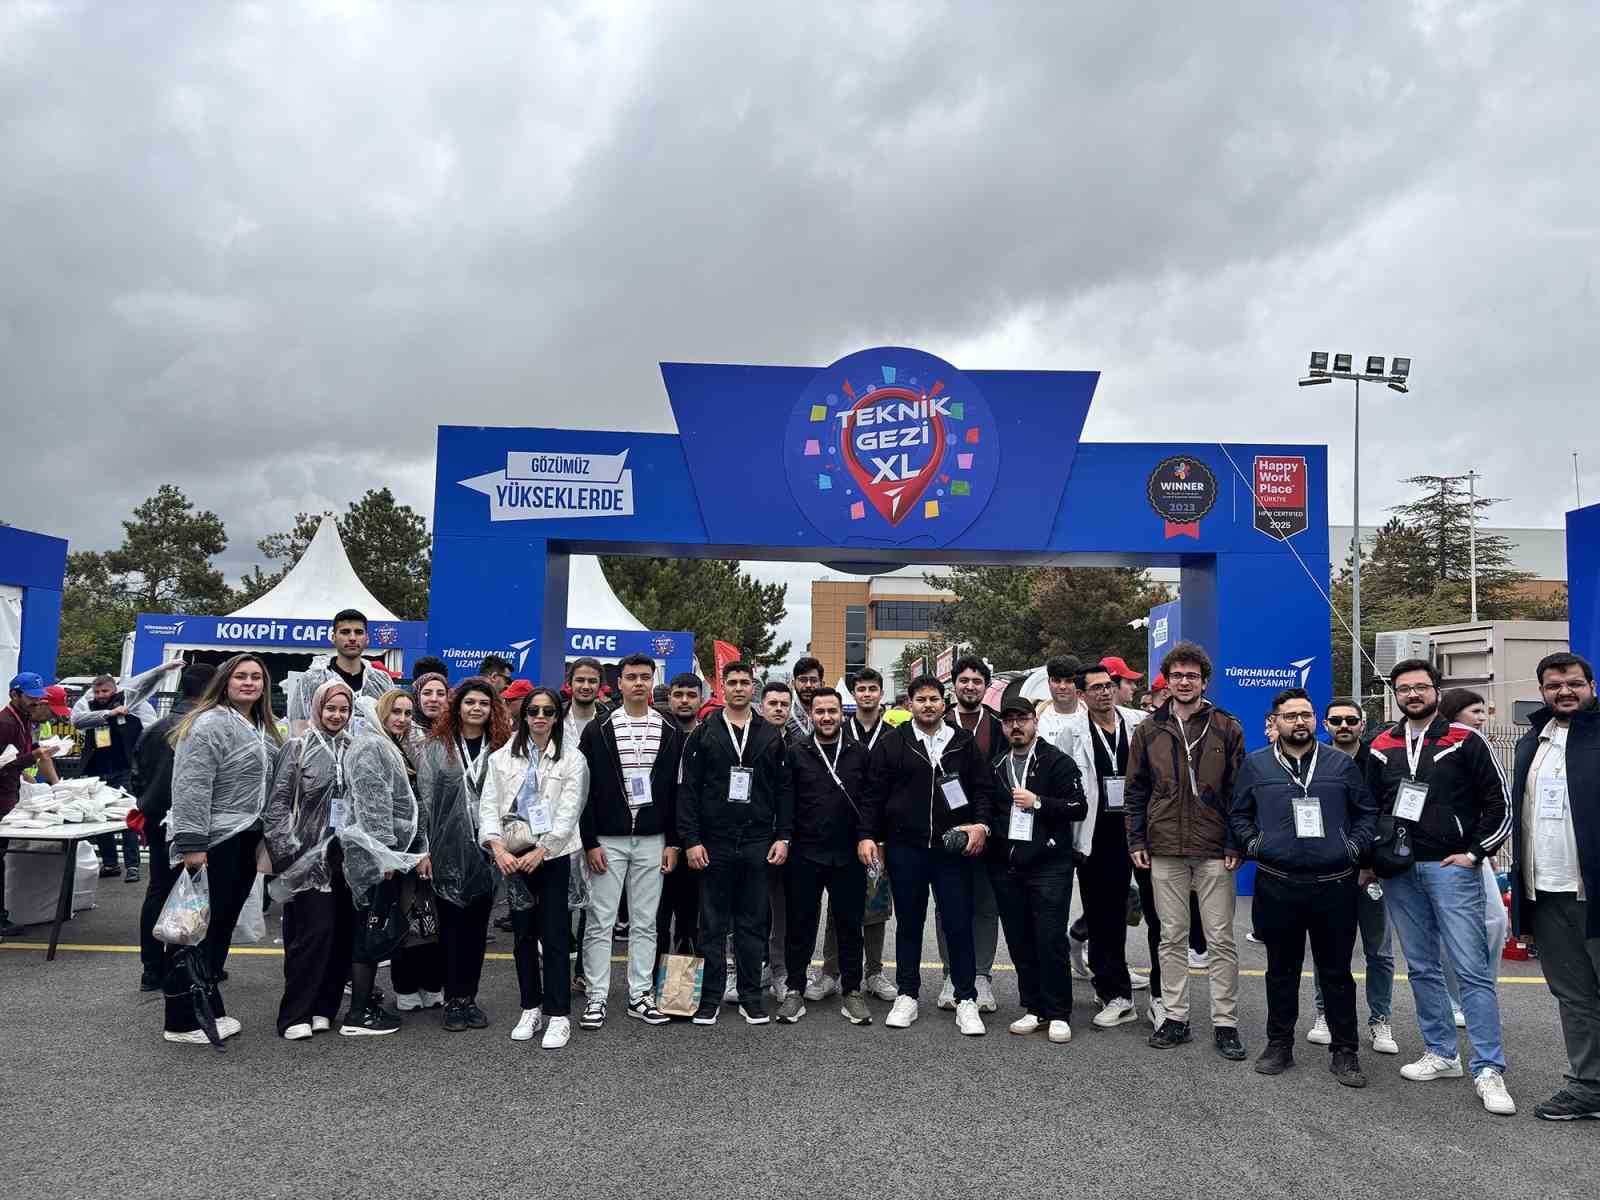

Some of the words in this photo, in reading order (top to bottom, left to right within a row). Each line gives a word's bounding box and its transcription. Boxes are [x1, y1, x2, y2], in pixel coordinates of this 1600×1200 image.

[835, 395, 951, 428] TEKNİK
[856, 421, 928, 451] GEZİ
[531, 455, 590, 474] GÖZÜMÜZ
[870, 453, 921, 484] XL
[1259, 460, 1298, 472] Happy
[1259, 471, 1291, 481] Work
[496, 481, 624, 511] YÜKSEKLERDE
[1160, 482, 1204, 491] WINNER
[1259, 483, 1292, 493] Place
[216, 621, 288, 640] KOKPİT
[571, 634, 617, 651] CAFE
